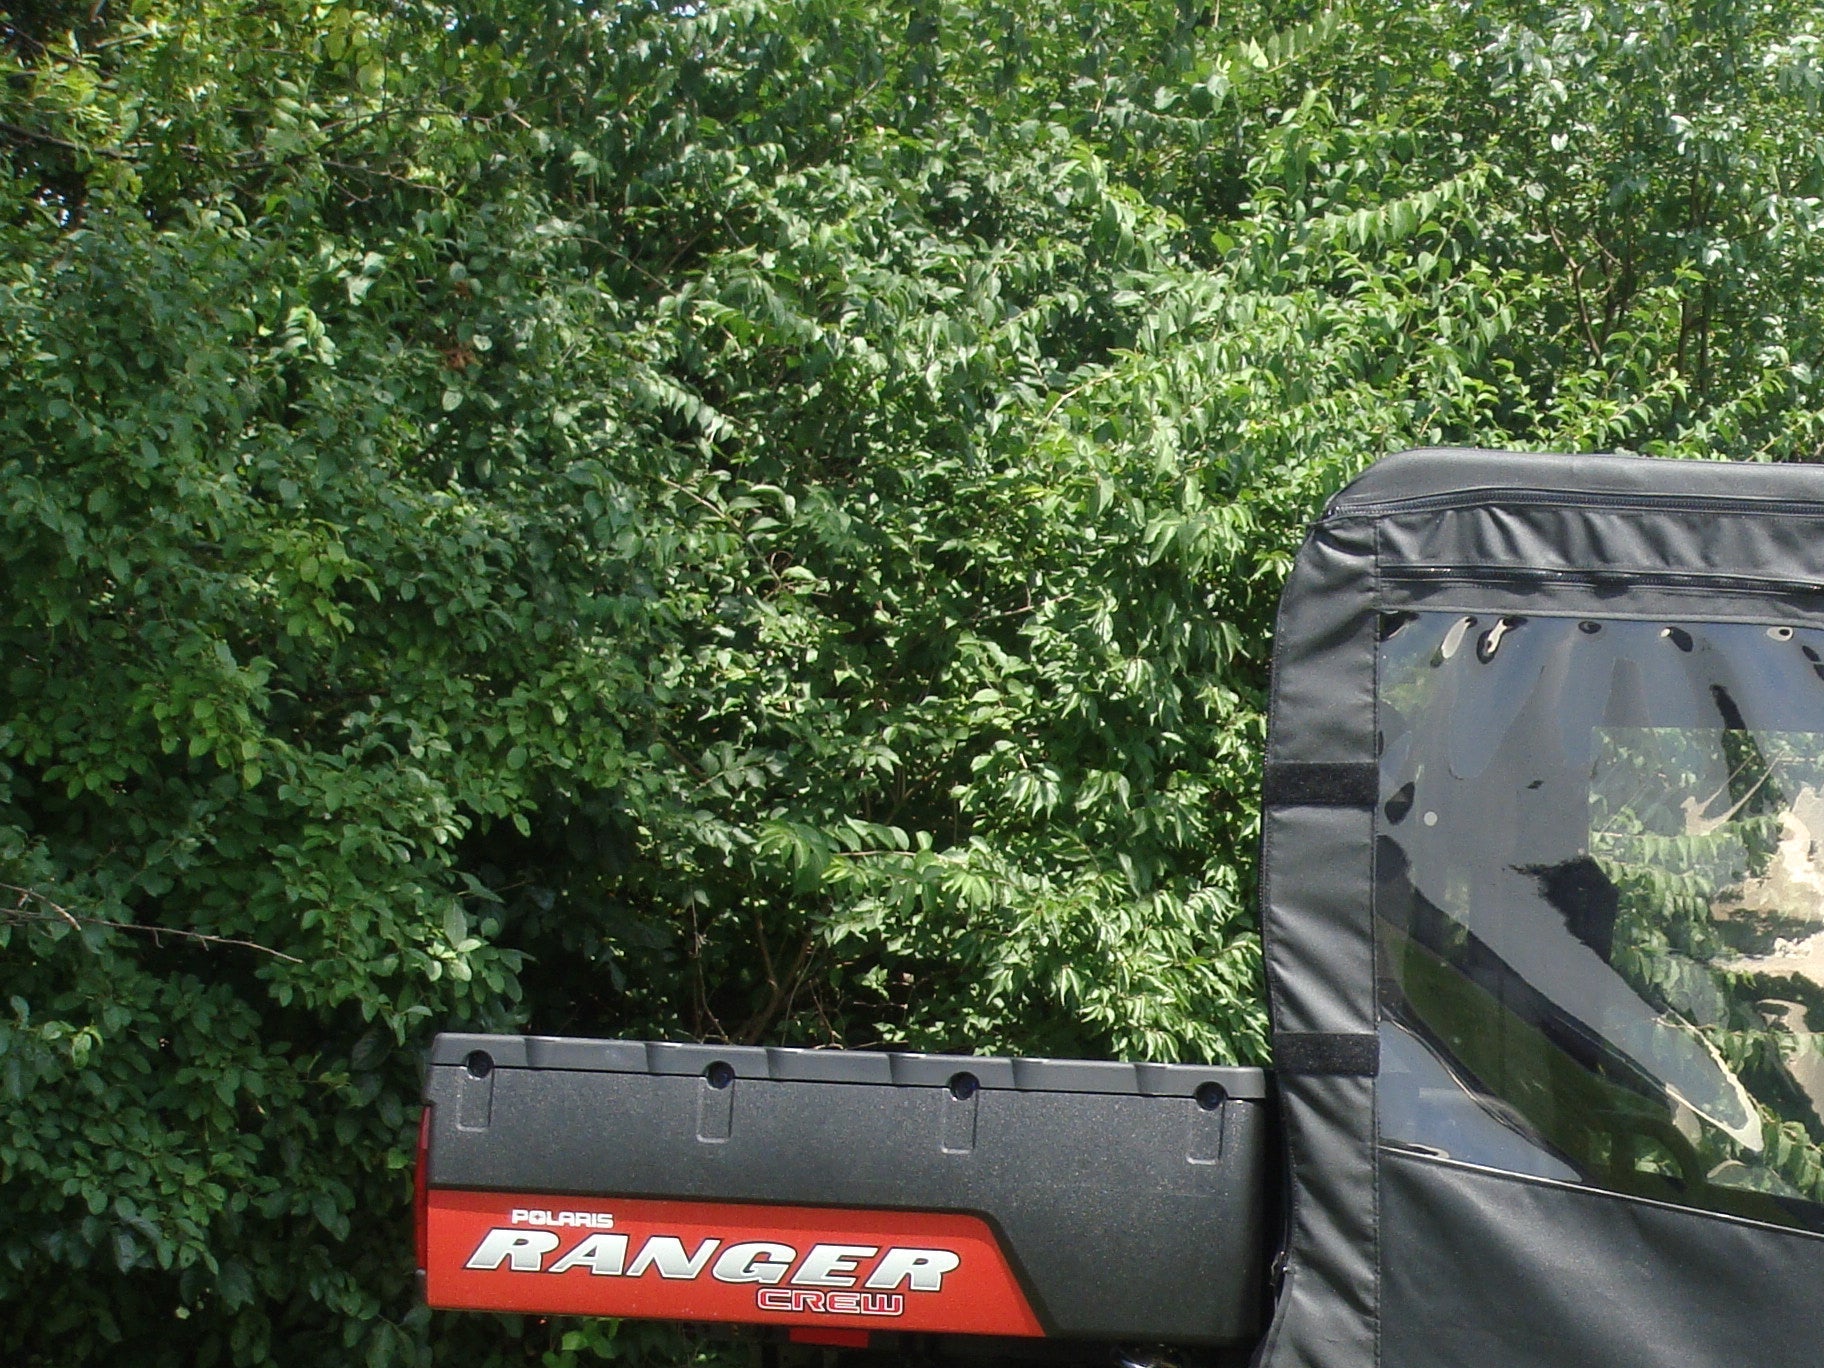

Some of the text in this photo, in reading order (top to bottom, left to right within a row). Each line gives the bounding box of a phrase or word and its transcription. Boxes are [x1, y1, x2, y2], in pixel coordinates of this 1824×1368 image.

[511, 1208, 614, 1229] POLARIS
[464, 1228, 961, 1292] RANGER
[756, 1288, 904, 1317] CREW
